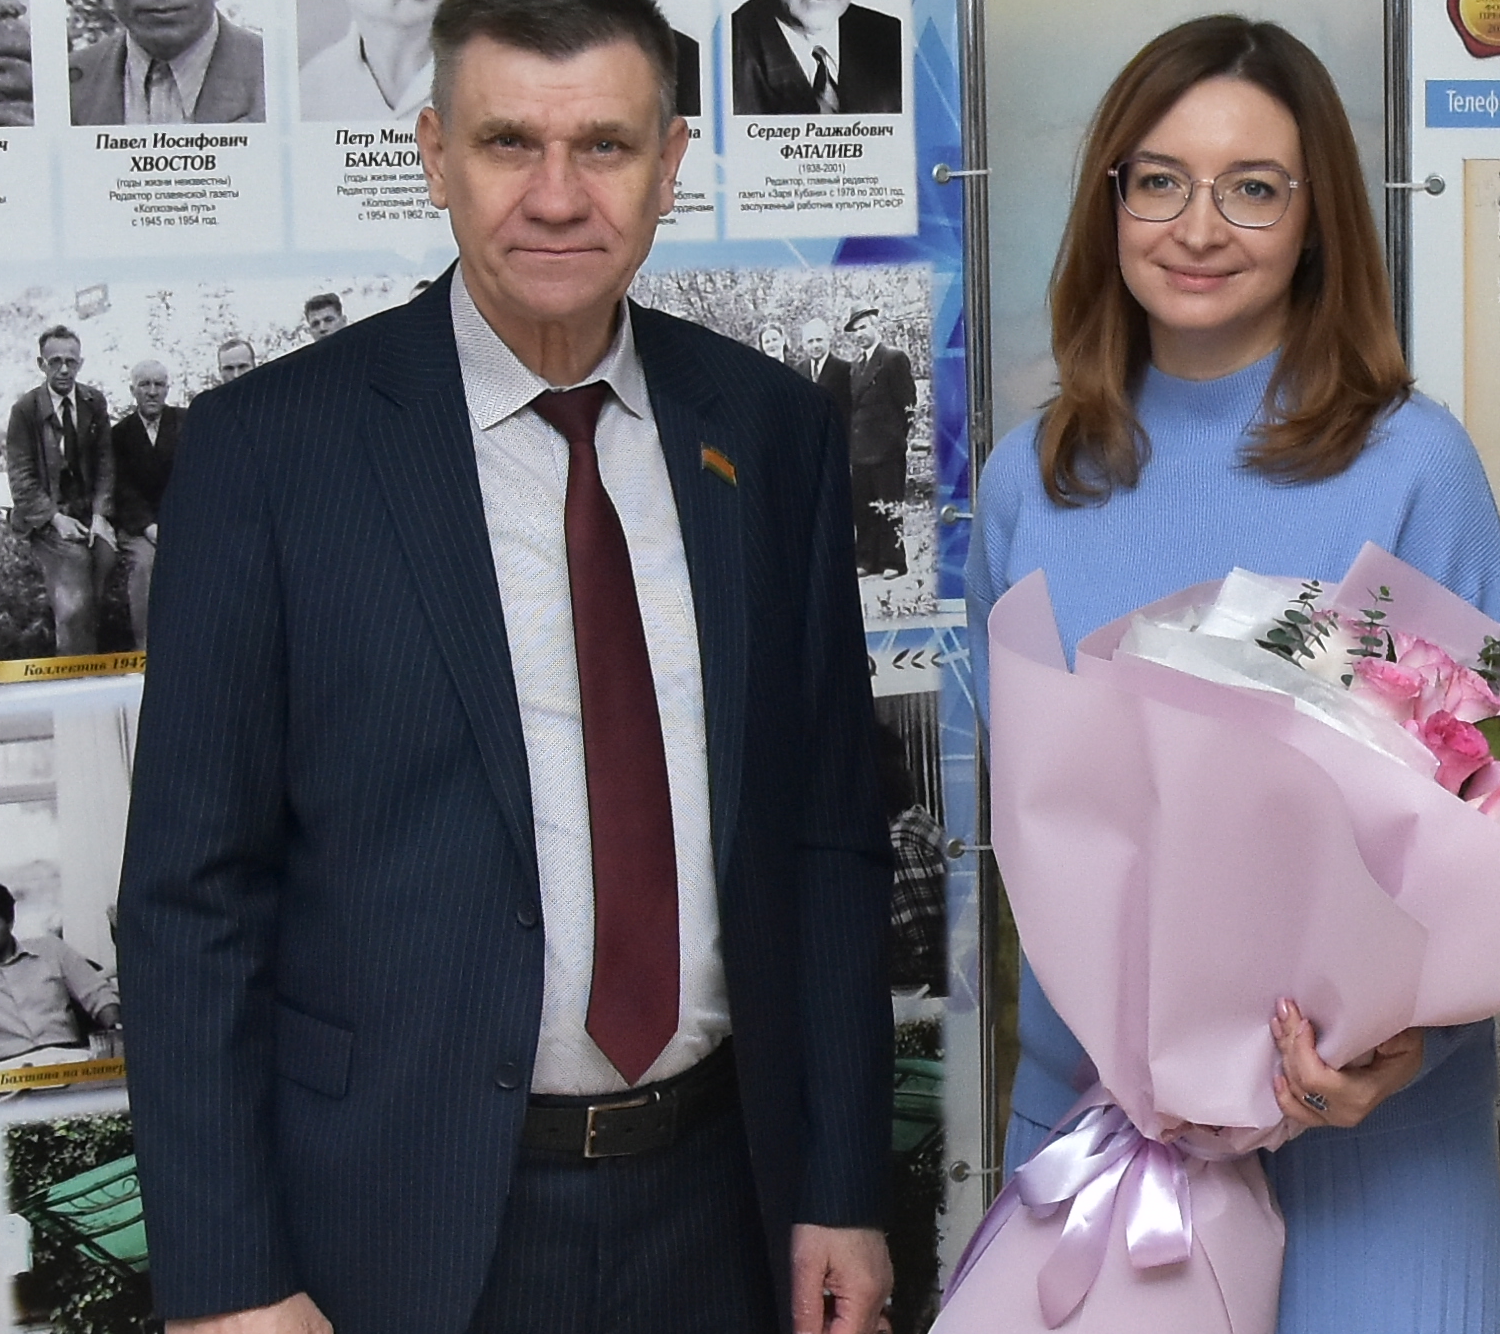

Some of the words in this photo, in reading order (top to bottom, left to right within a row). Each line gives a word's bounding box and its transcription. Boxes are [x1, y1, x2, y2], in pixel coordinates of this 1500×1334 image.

[335, 129, 374, 148] Петр
[746, 122, 800, 141] Сердер
[804, 121, 893, 137] Раджабович
[96, 133, 147, 149] Павел
[152, 132, 248, 151] Иосифович
[780, 143, 863, 159] ФАТАЛИЕВ
[130, 154, 216, 172] ХВОСТОВ
[112, 654, 147, 672] 1947
